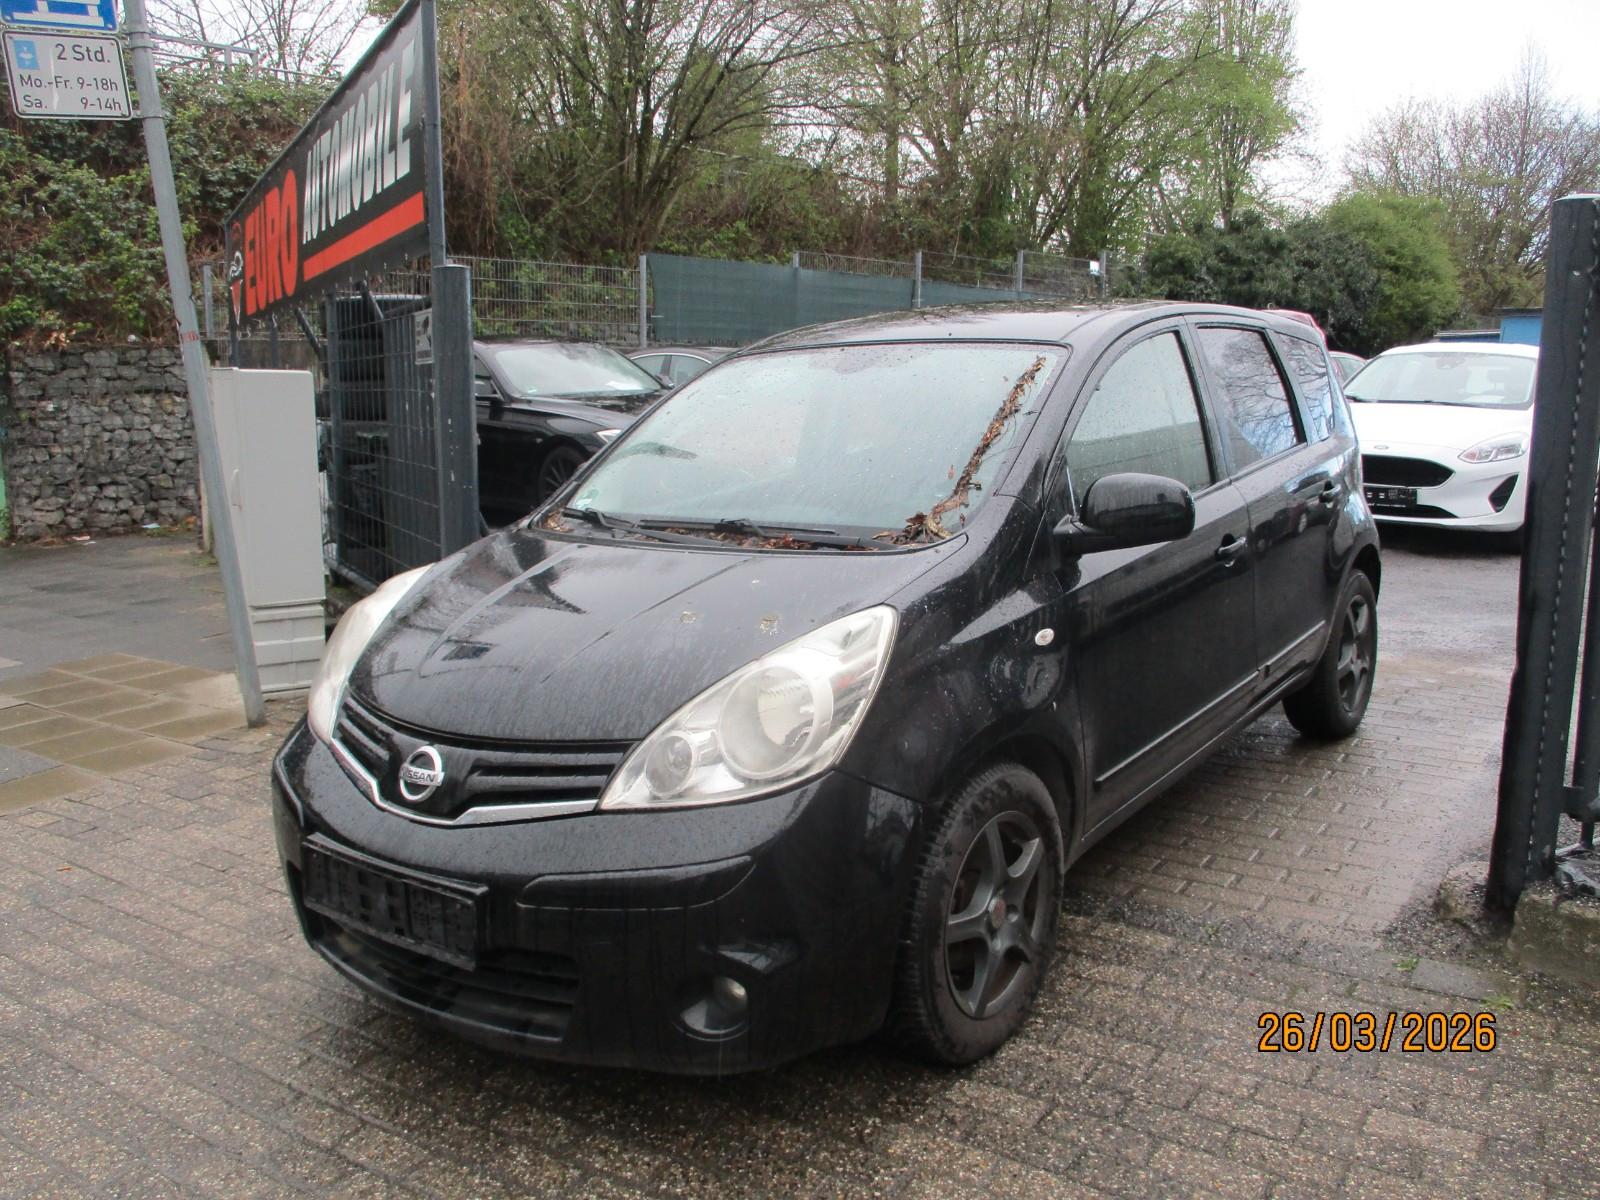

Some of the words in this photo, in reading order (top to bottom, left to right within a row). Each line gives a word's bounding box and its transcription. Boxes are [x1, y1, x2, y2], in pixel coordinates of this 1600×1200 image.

[76, 76, 119, 92] 9-18h
[23, 94, 48, 109] Sa.
[80, 97, 122, 112] 9-14h
[244, 168, 298, 316] EURO
[302, 39, 415, 245] AUTOMOBILE
